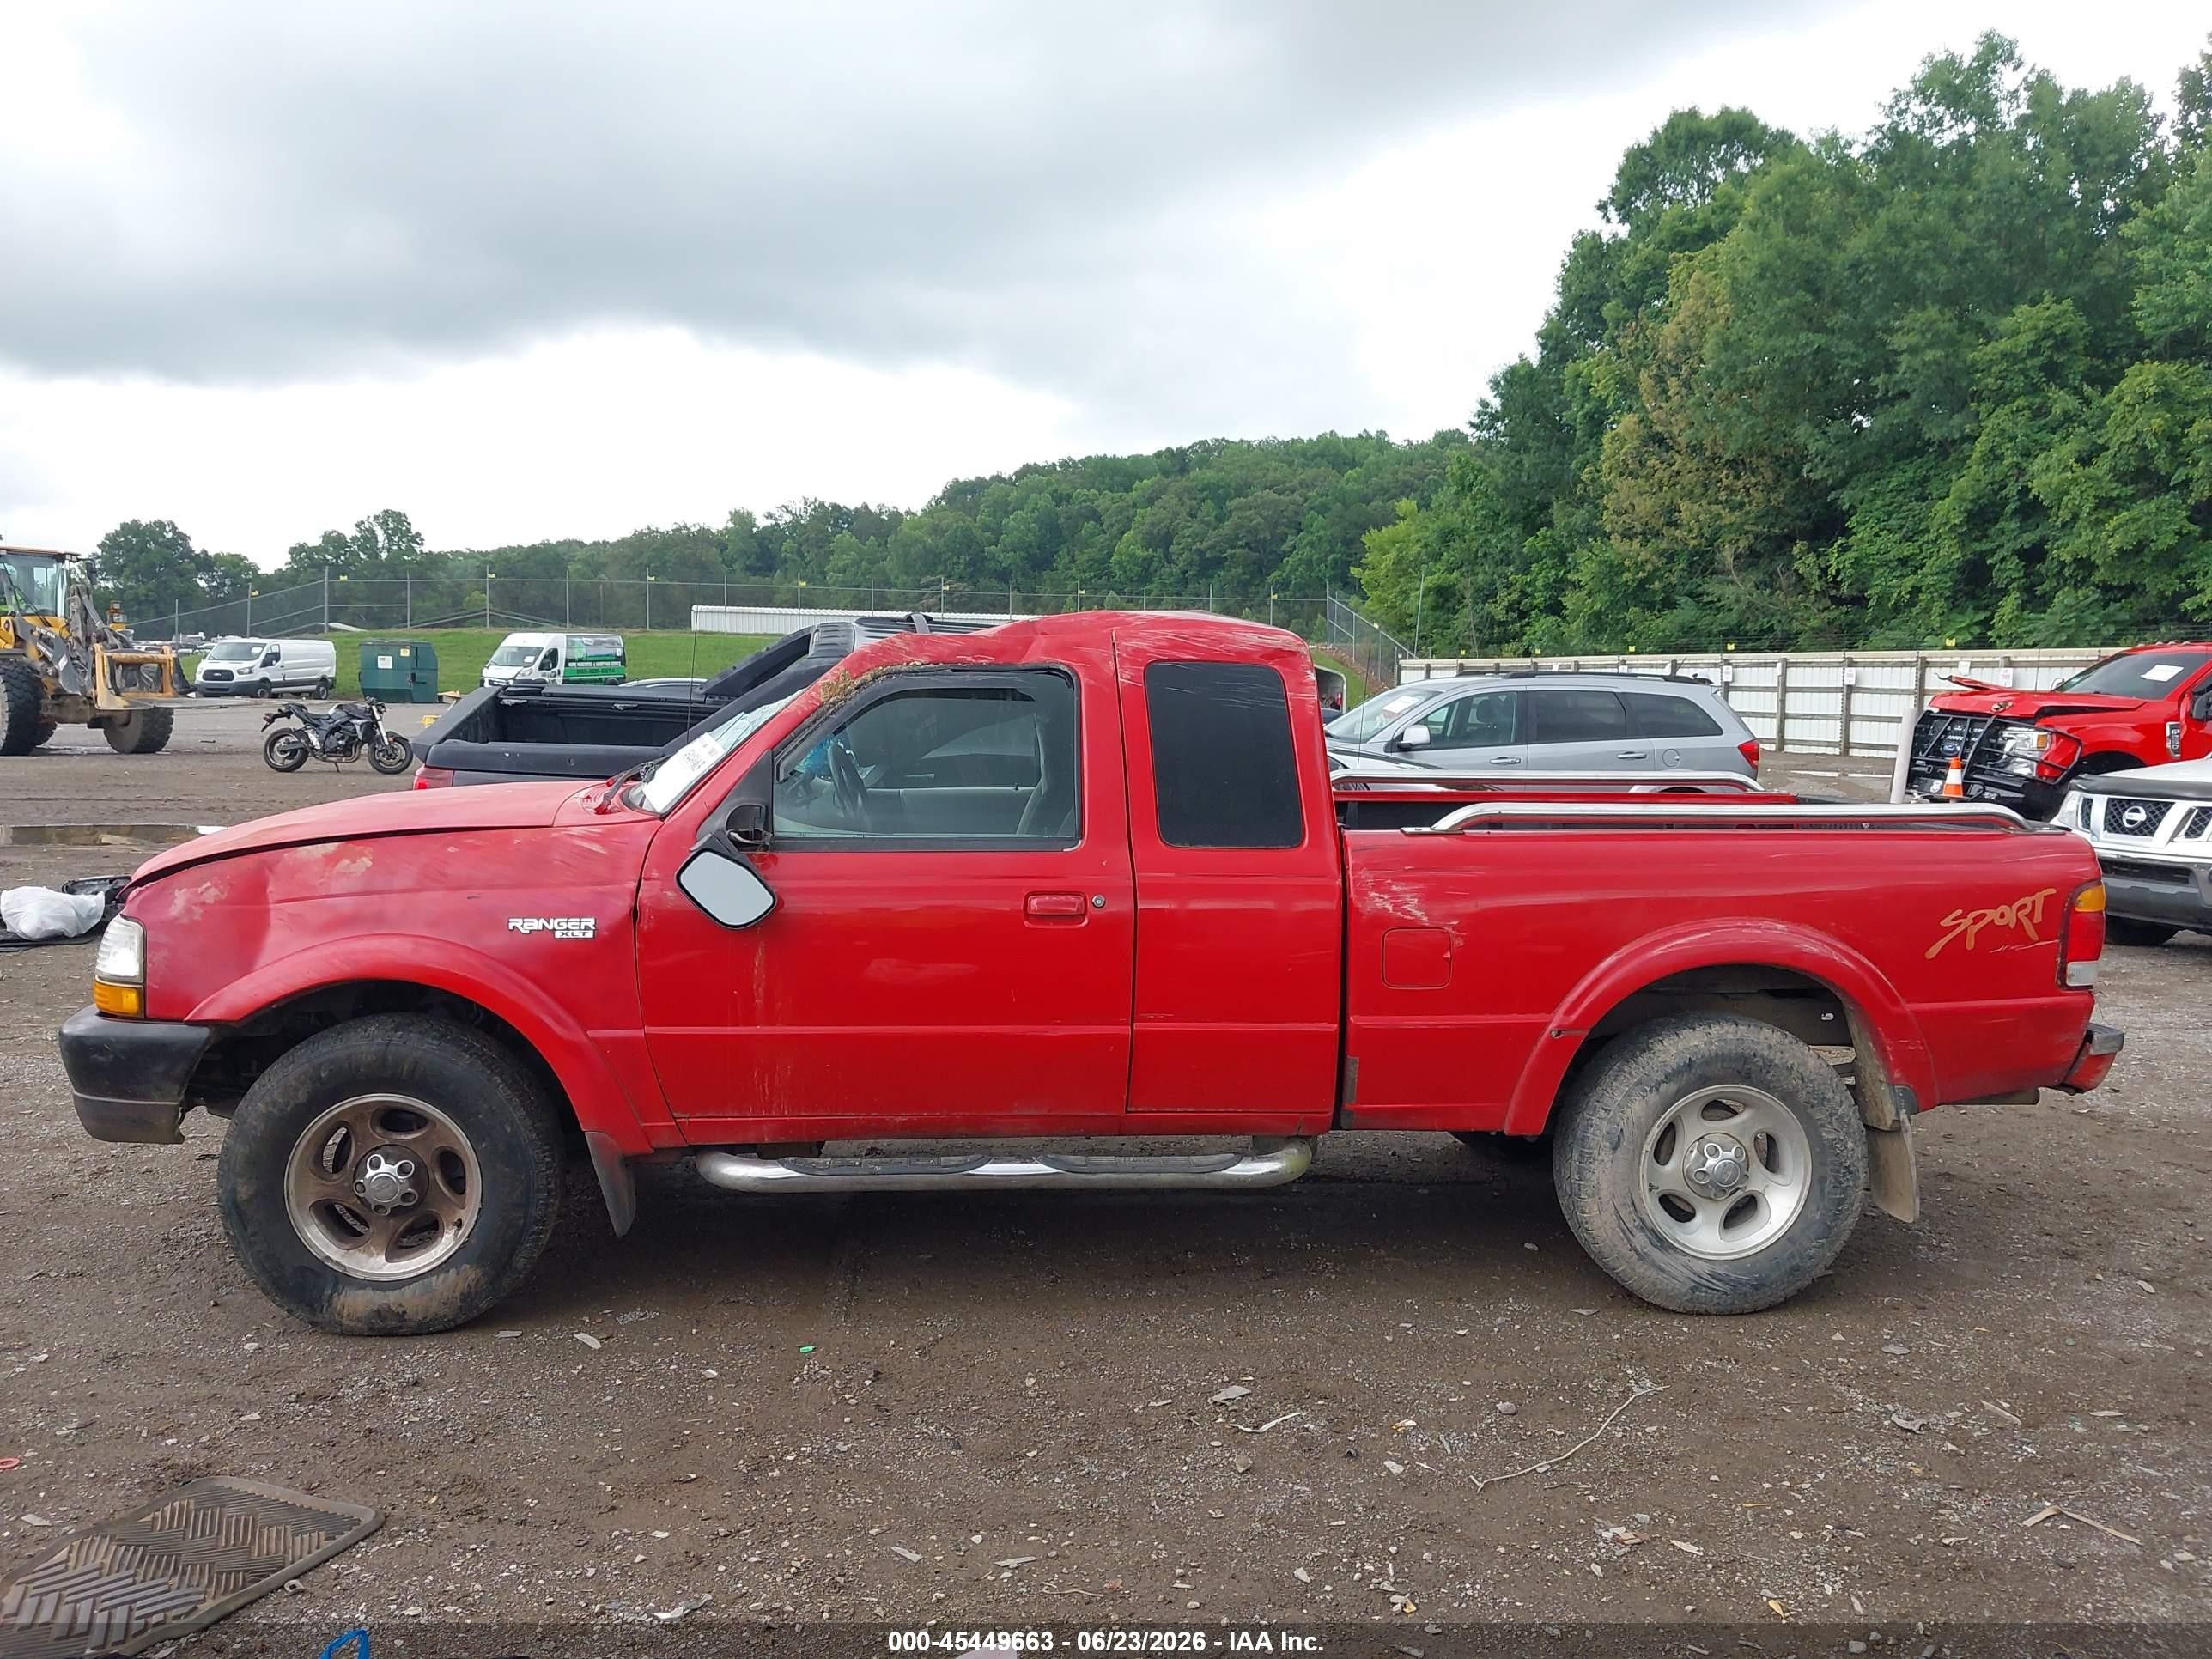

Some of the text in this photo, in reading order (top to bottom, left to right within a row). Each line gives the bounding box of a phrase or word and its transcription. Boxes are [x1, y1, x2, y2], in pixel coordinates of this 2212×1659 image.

[507, 917, 596, 934] RANGER
[1924, 888, 2057, 960] SPORT
[557, 930, 591, 939] XLT
